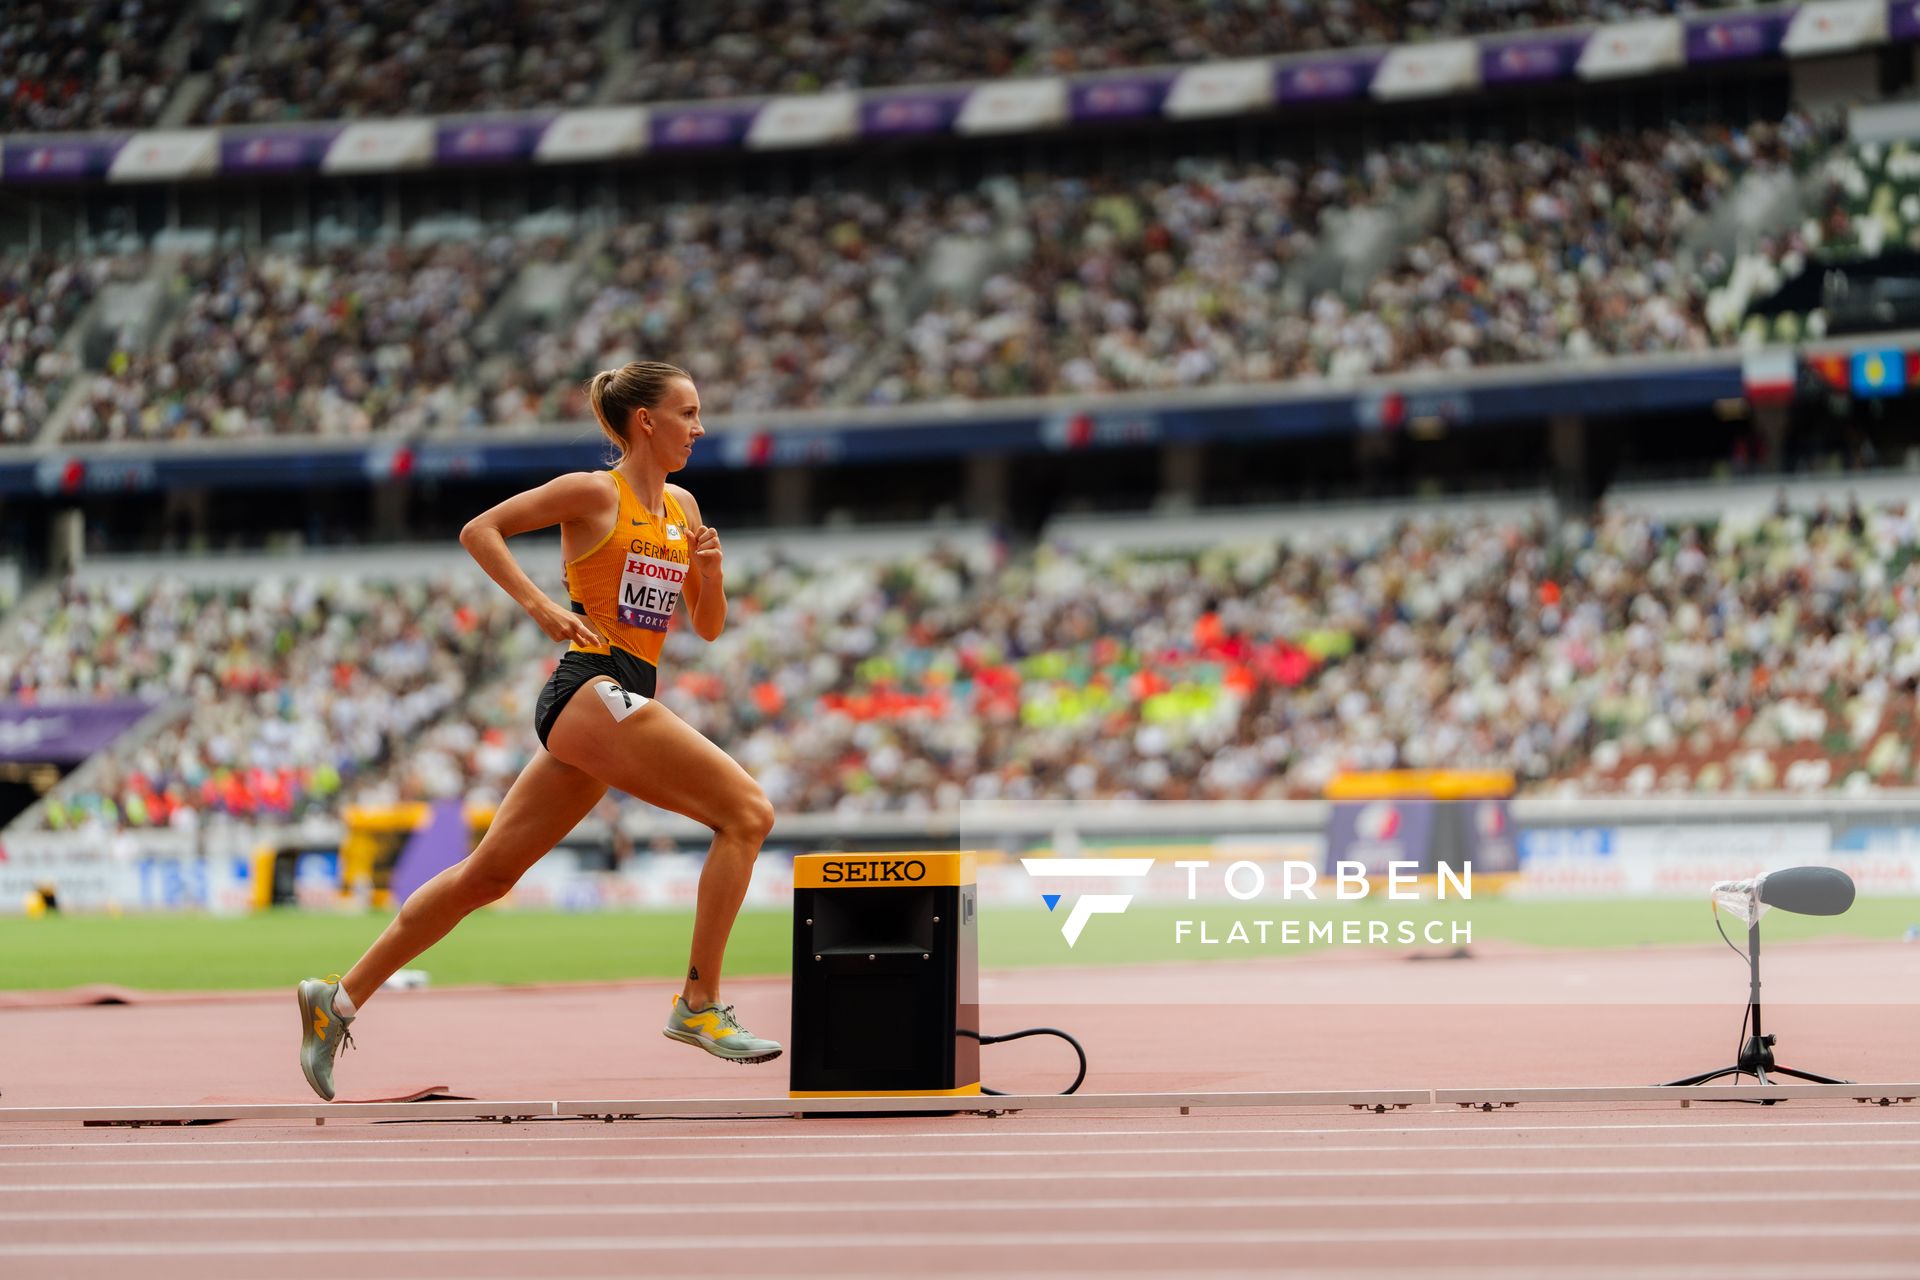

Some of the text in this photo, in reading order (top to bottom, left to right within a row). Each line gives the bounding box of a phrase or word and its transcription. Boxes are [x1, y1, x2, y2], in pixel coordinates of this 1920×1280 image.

[630, 539, 688, 565] GERMAN
[624, 582, 679, 612] MEYE
[822, 860, 926, 883] SEIKO
